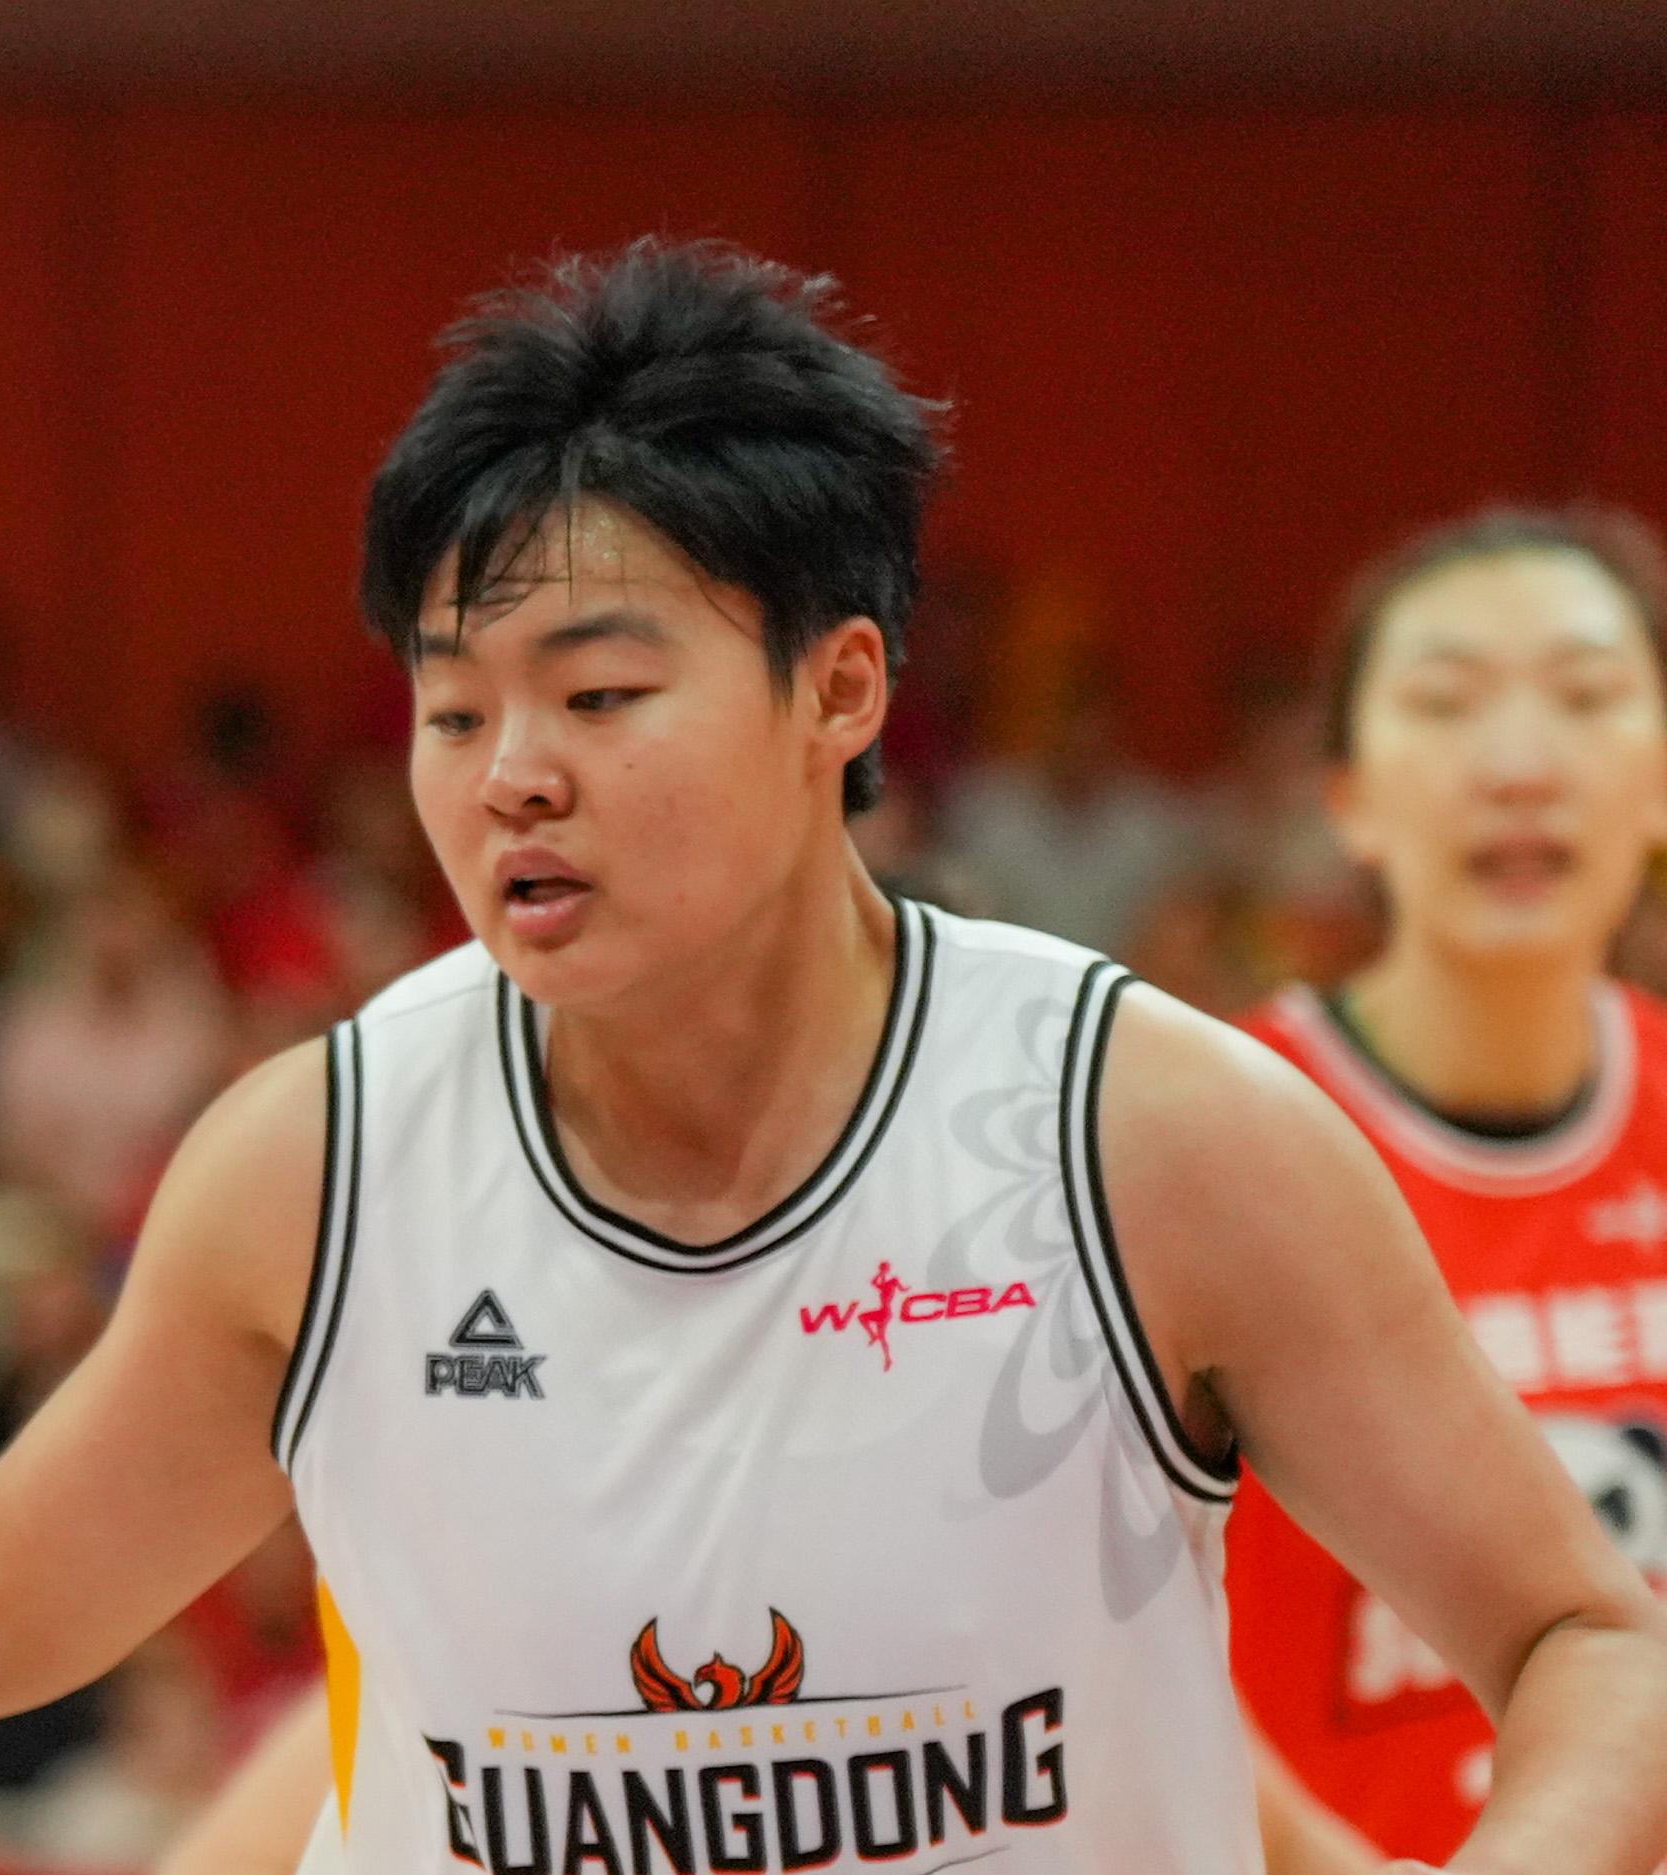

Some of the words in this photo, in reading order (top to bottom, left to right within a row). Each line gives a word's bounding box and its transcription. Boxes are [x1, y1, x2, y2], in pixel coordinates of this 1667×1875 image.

[425, 1353, 547, 1399] PEAK
[487, 1727, 631, 1755] WOMEN
[673, 1699, 975, 1752] BASKETBALL
